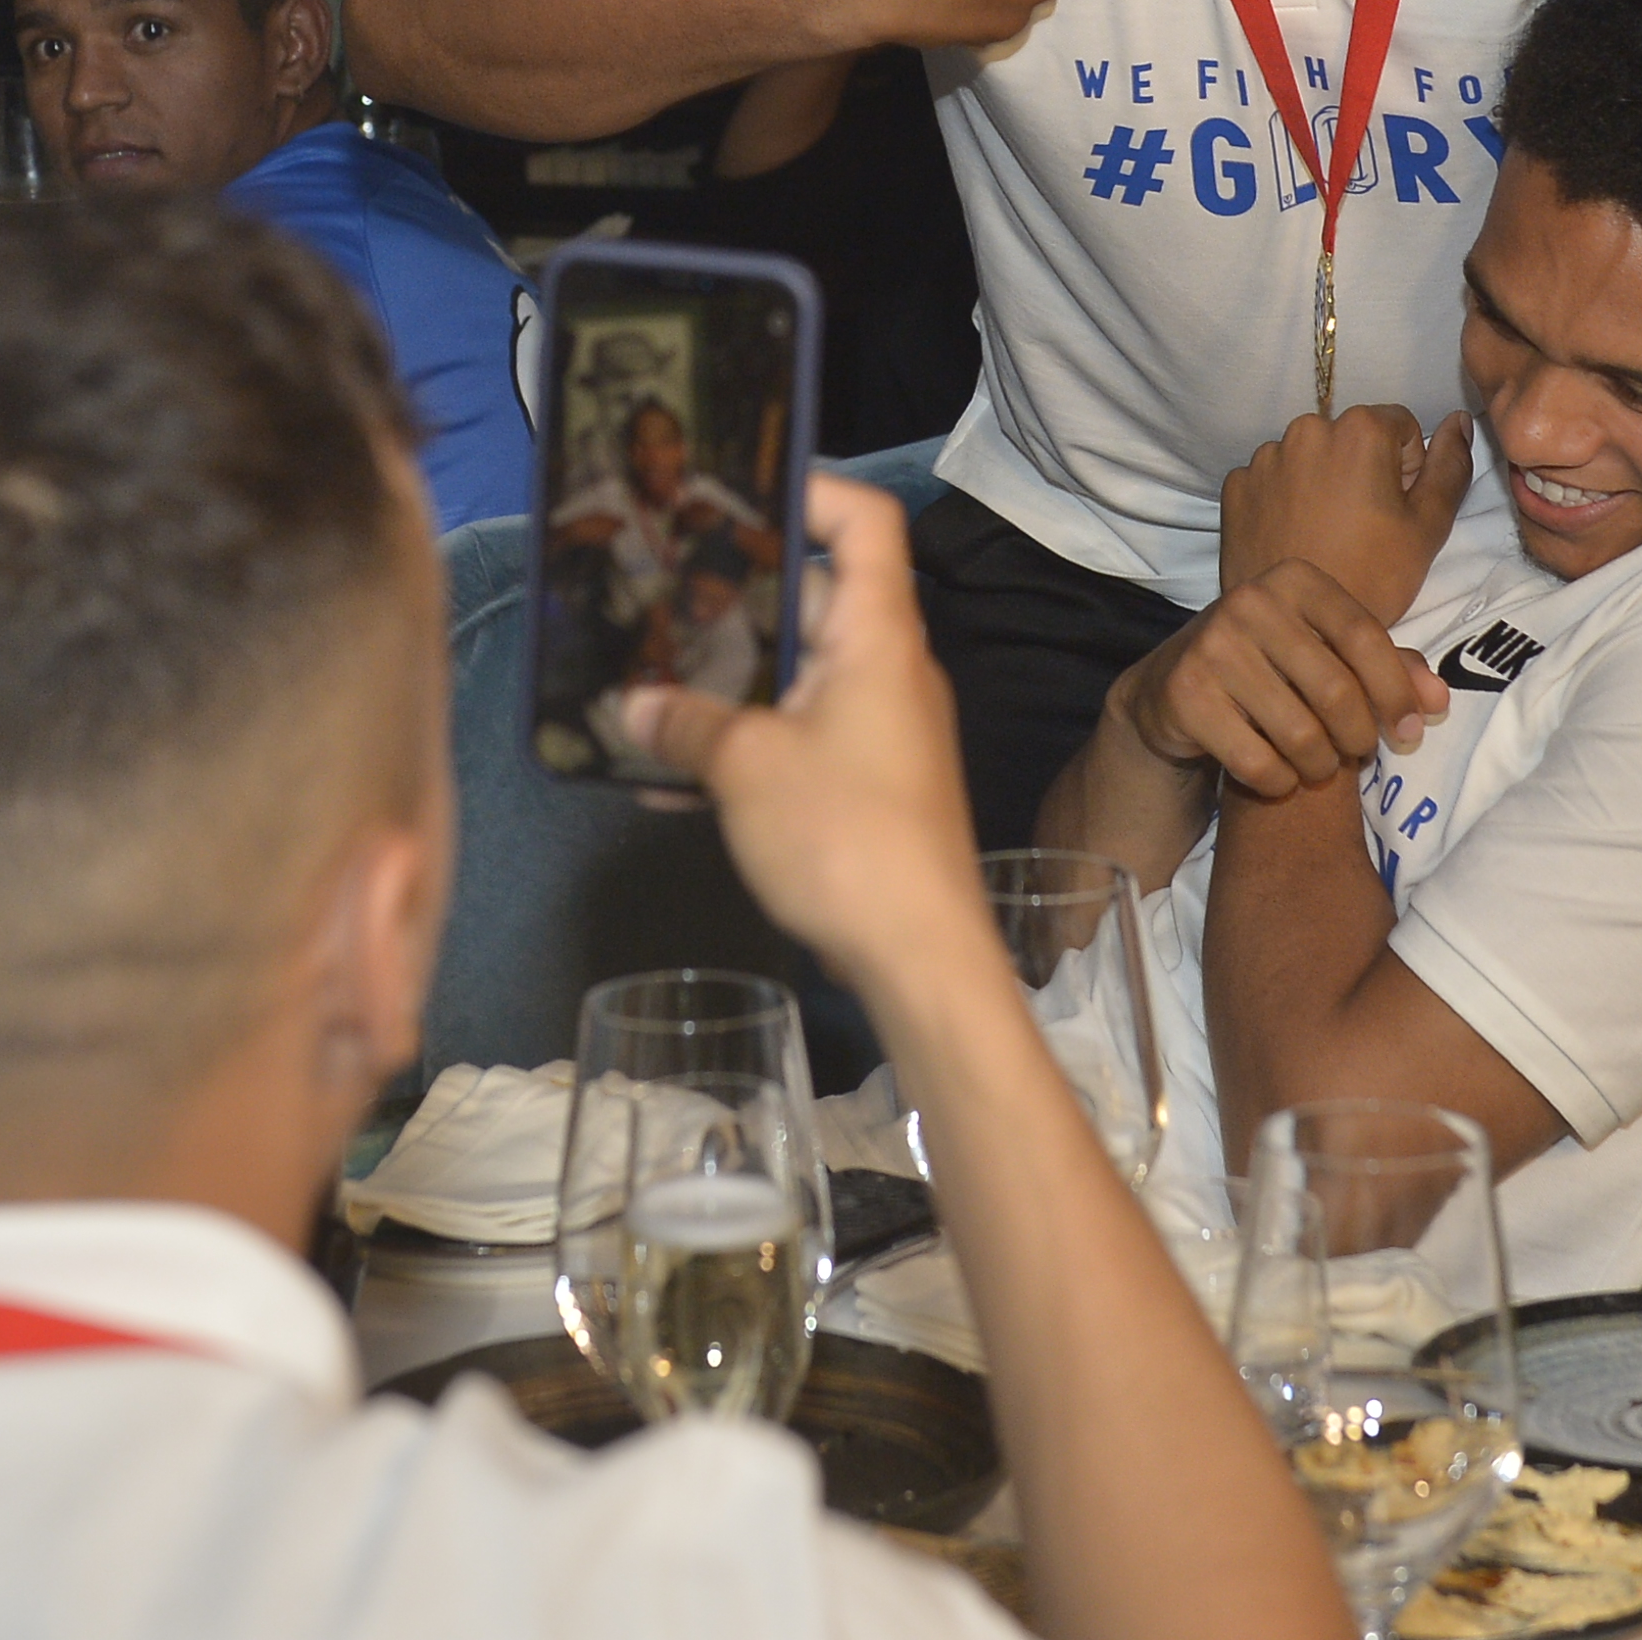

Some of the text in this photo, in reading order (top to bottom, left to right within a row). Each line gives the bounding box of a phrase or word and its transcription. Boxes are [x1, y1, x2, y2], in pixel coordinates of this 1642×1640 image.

[1075, 56, 1511, 106] WE FIH FO
[1464, 618, 1546, 681] NIK
[1361, 756, 1439, 840] FOR
